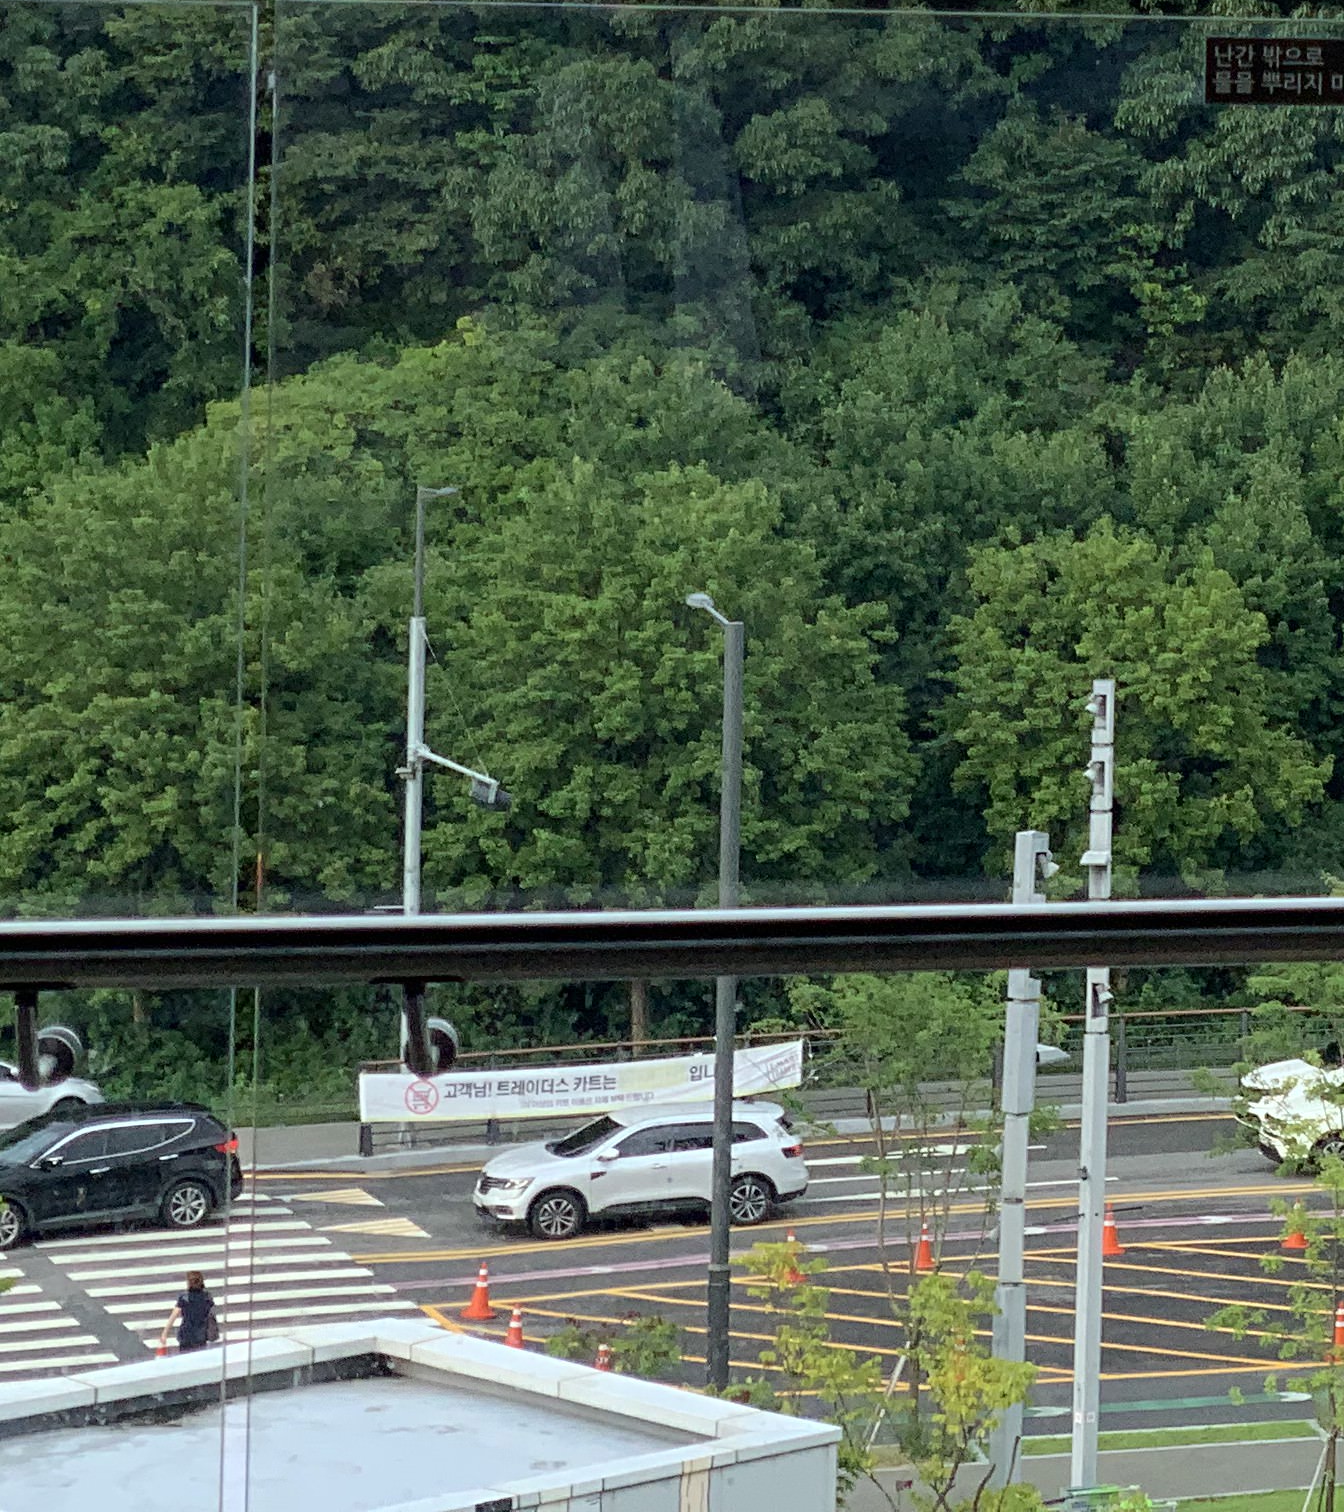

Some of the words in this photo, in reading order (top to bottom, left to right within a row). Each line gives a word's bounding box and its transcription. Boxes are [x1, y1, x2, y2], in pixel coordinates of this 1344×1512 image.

[1215, 43, 1254, 67] 난간
[1263, 45, 1325, 68] 밖으로
[1212, 70, 1255, 94] 물을
[1261, 71, 1322, 95] 뿌리지
[444, 1081, 492, 1098] 고객님!
[496, 1078, 569, 1096] 트레이더스
[573, 1075, 617, 1093] 카트는
